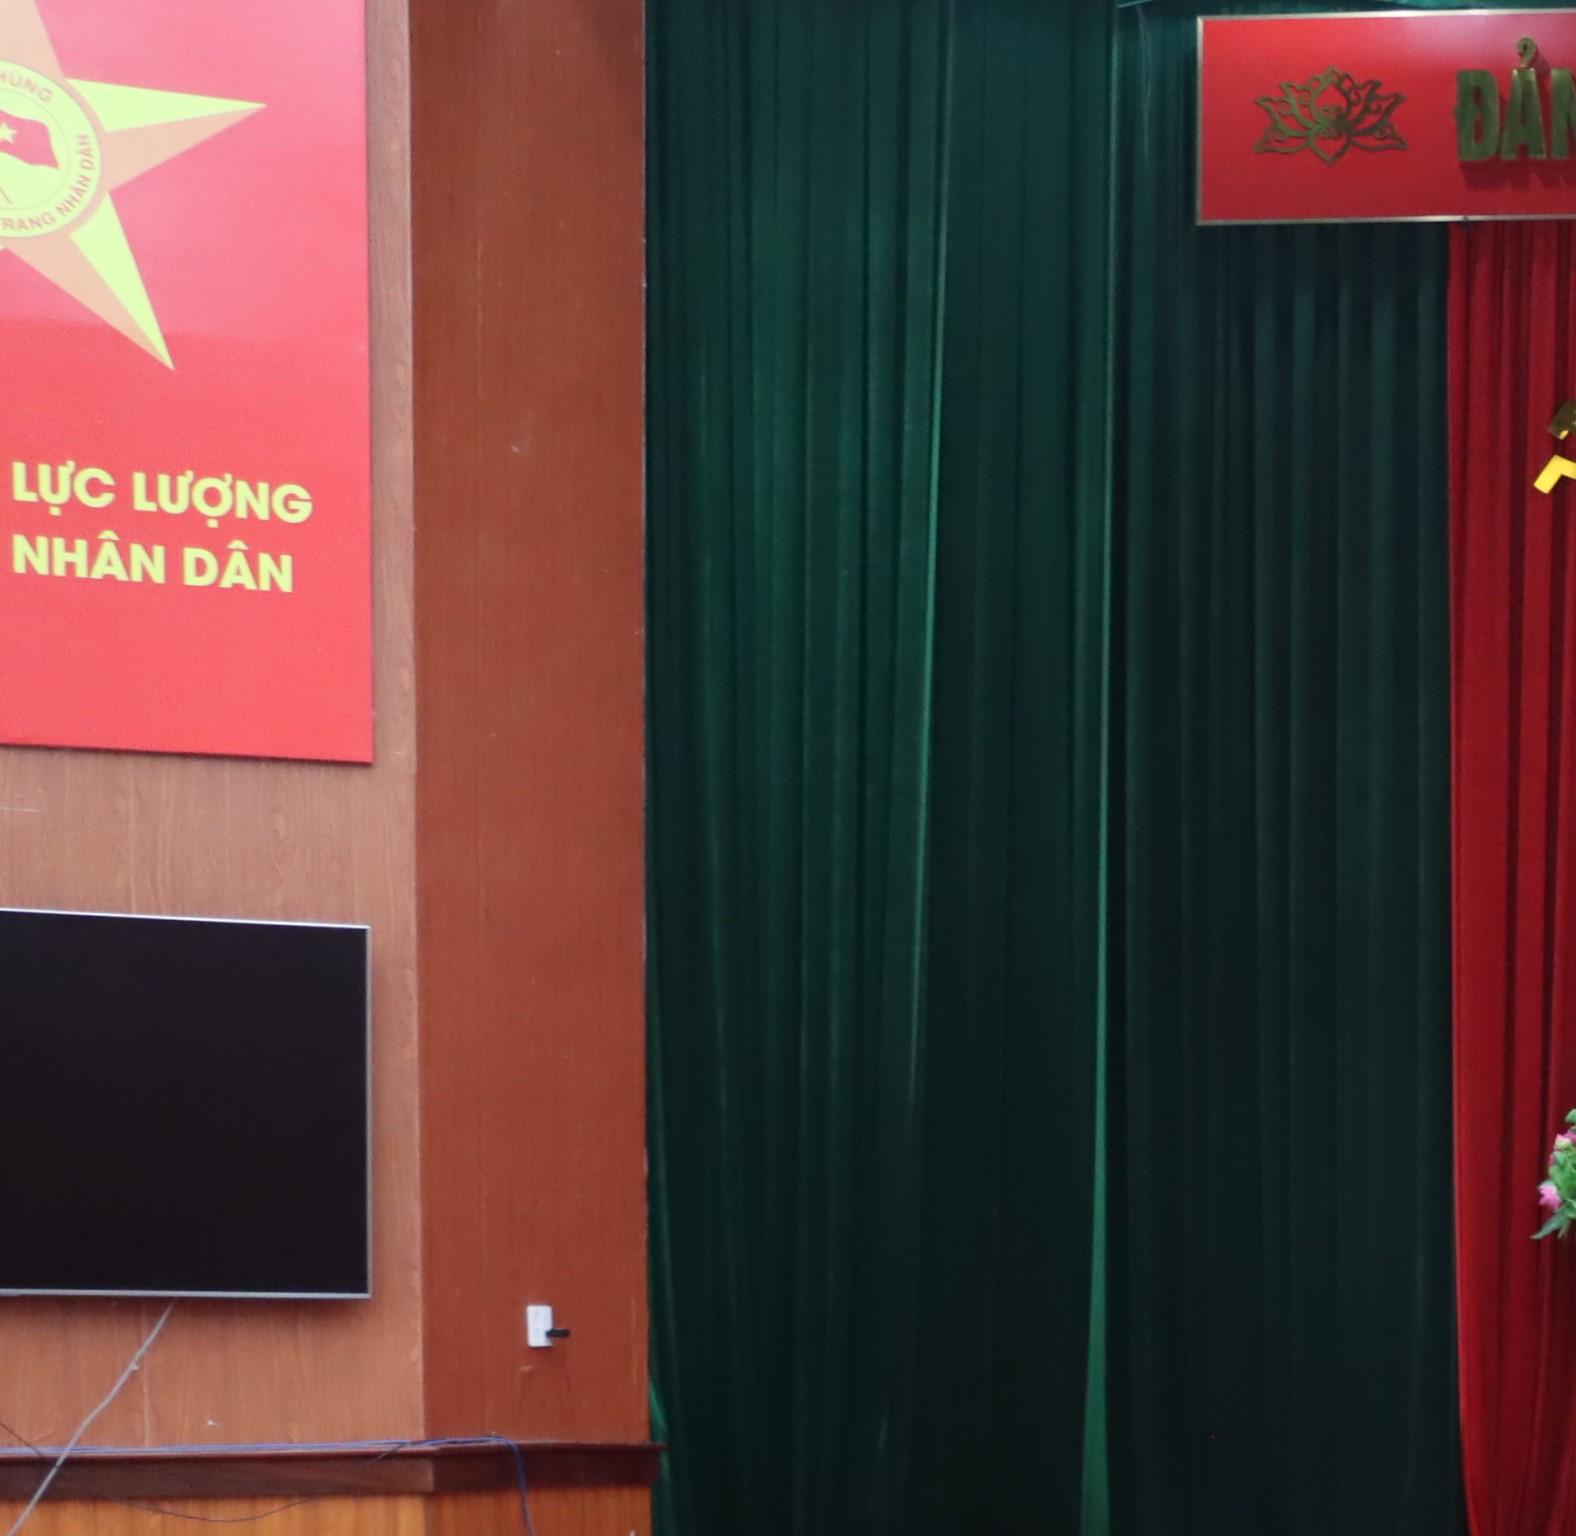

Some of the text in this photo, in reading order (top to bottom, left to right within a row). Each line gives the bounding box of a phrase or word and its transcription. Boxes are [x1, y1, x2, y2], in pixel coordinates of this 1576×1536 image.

[0, 210, 57, 231] RANG
[13, 460, 312, 527] LỰC LƯỢNG
[13, 530, 292, 592] NHÂN DÂN
